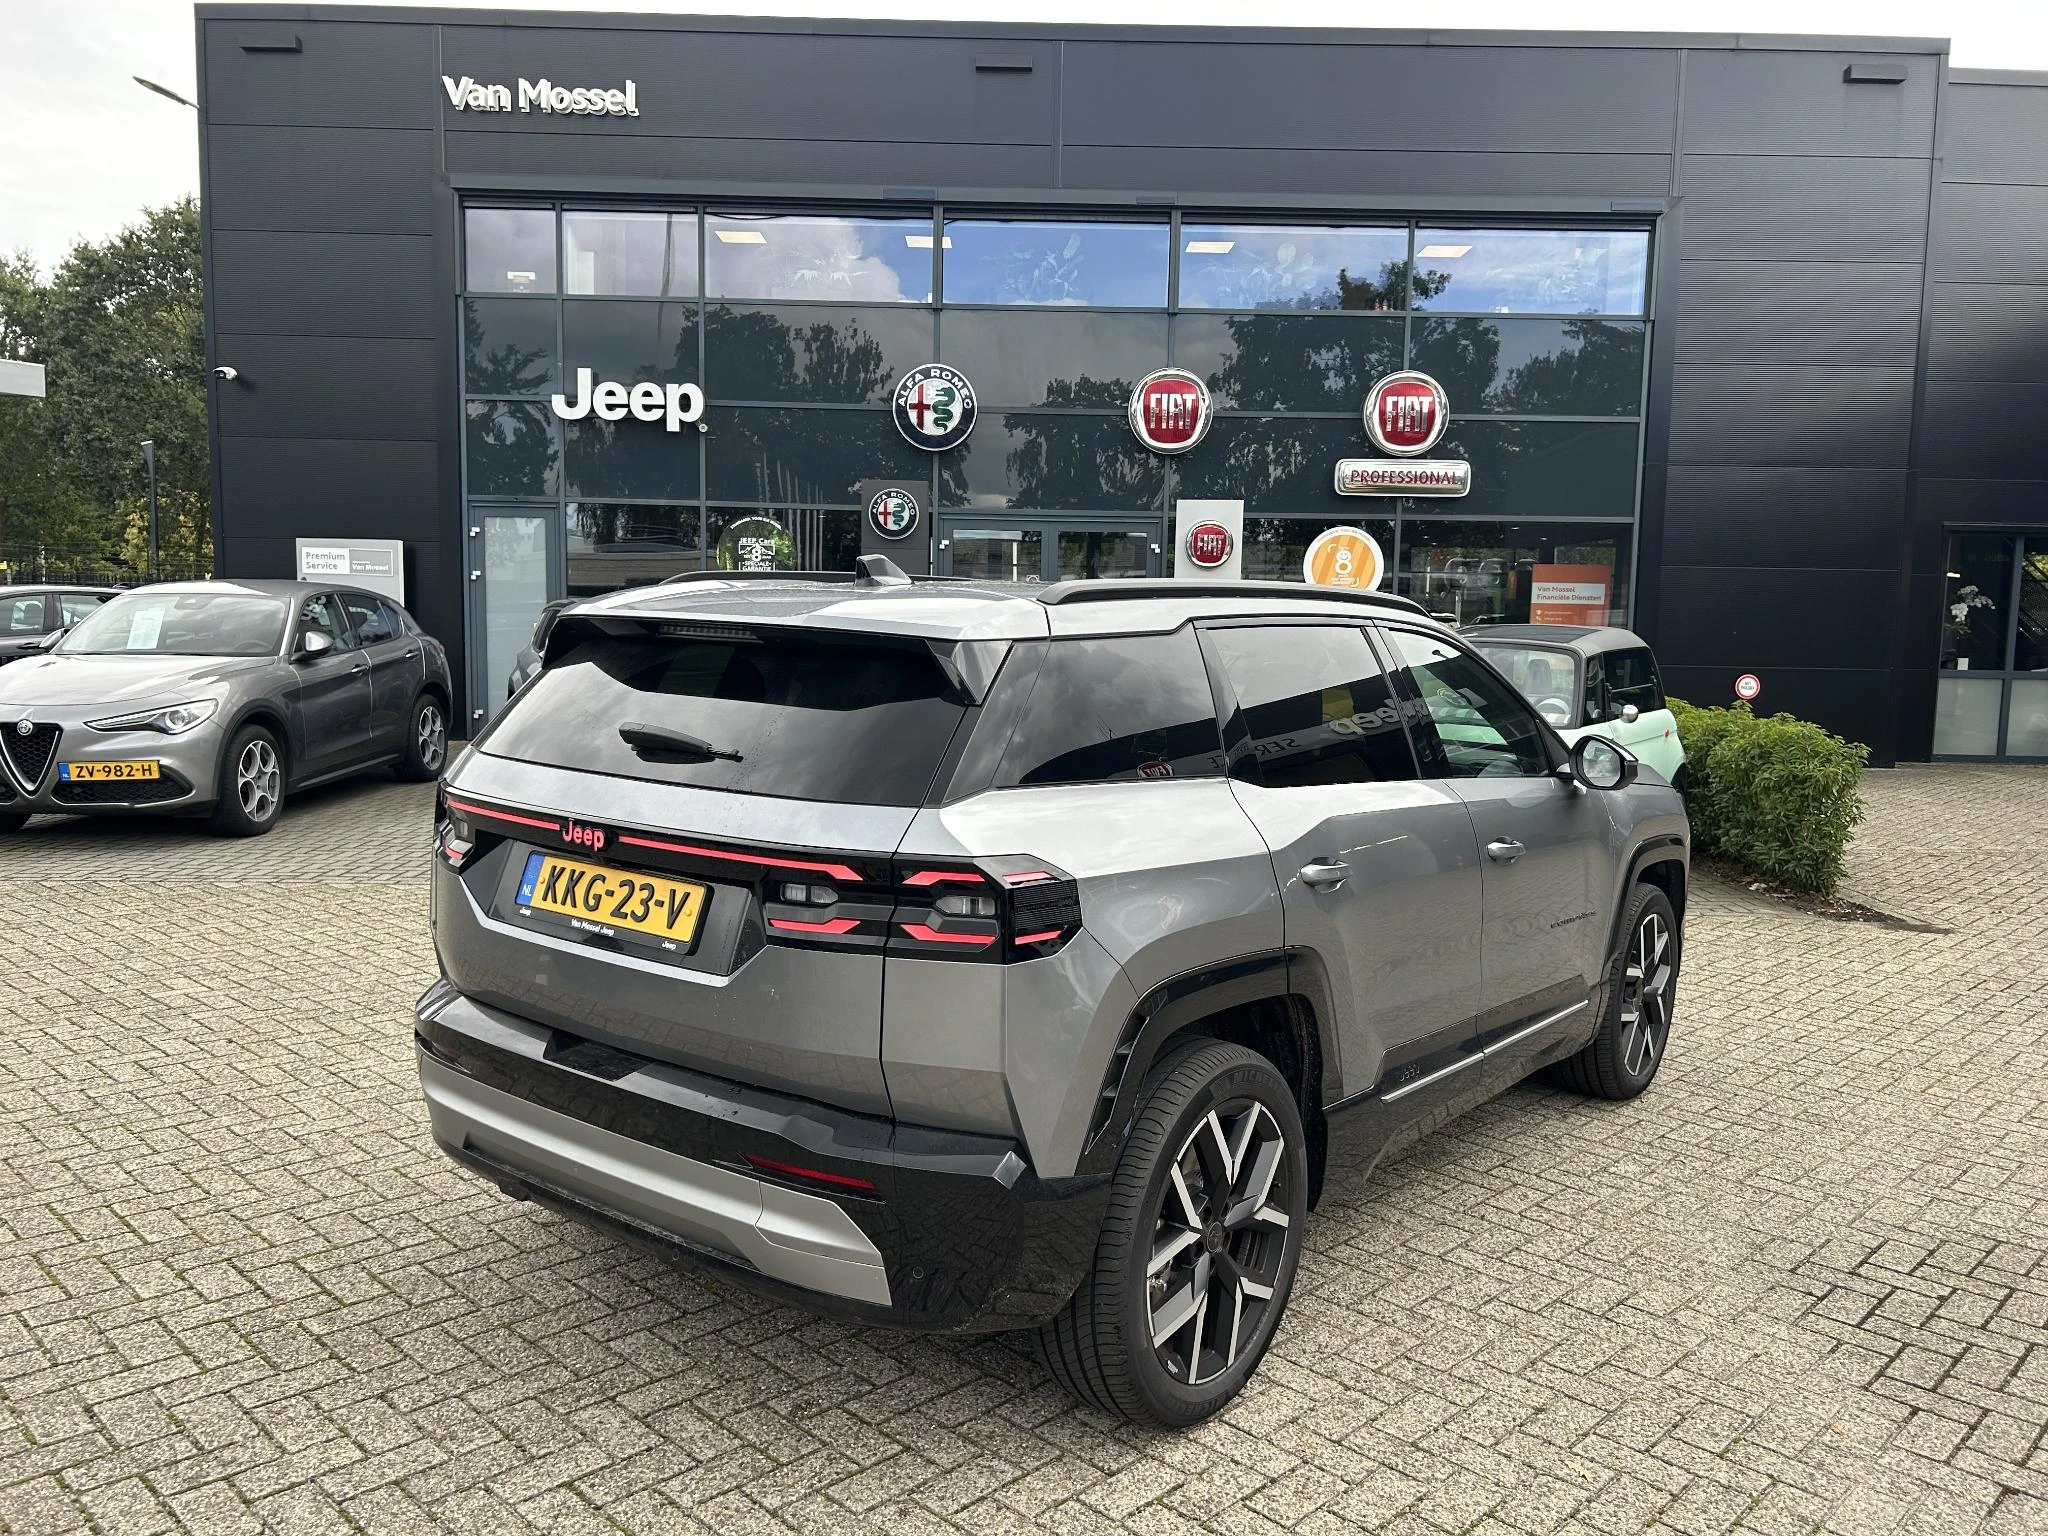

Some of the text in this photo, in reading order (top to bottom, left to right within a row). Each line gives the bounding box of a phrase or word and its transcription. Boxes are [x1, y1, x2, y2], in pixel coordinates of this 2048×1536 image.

[441, 75, 640, 116] Van Mossel
[898, 368, 973, 409] ALFA ROMEO
[551, 367, 704, 432] Jeep
[1150, 392, 1197, 430] FIAT
[1385, 395, 1434, 432] FIAT
[1350, 469, 1460, 486] PROFESSIONAL
[872, 492, 916, 515] ALFA ROMEO
[758, 537, 775, 545] Care
[1197, 534, 1225, 556] FIAT
[306, 552, 345, 561] Premium
[751, 548, 762, 562] 8
[306, 562, 338, 570] Service
[75, 764, 152, 778] ZV-982-H
[562, 819, 604, 851] Jeep
[522, 865, 690, 929] NL KKG-23-V
[519, 906, 532, 916] Jeep
[571, 918, 615, 936] Van Mossel Jeep
[662, 940, 677, 950] Jeep
